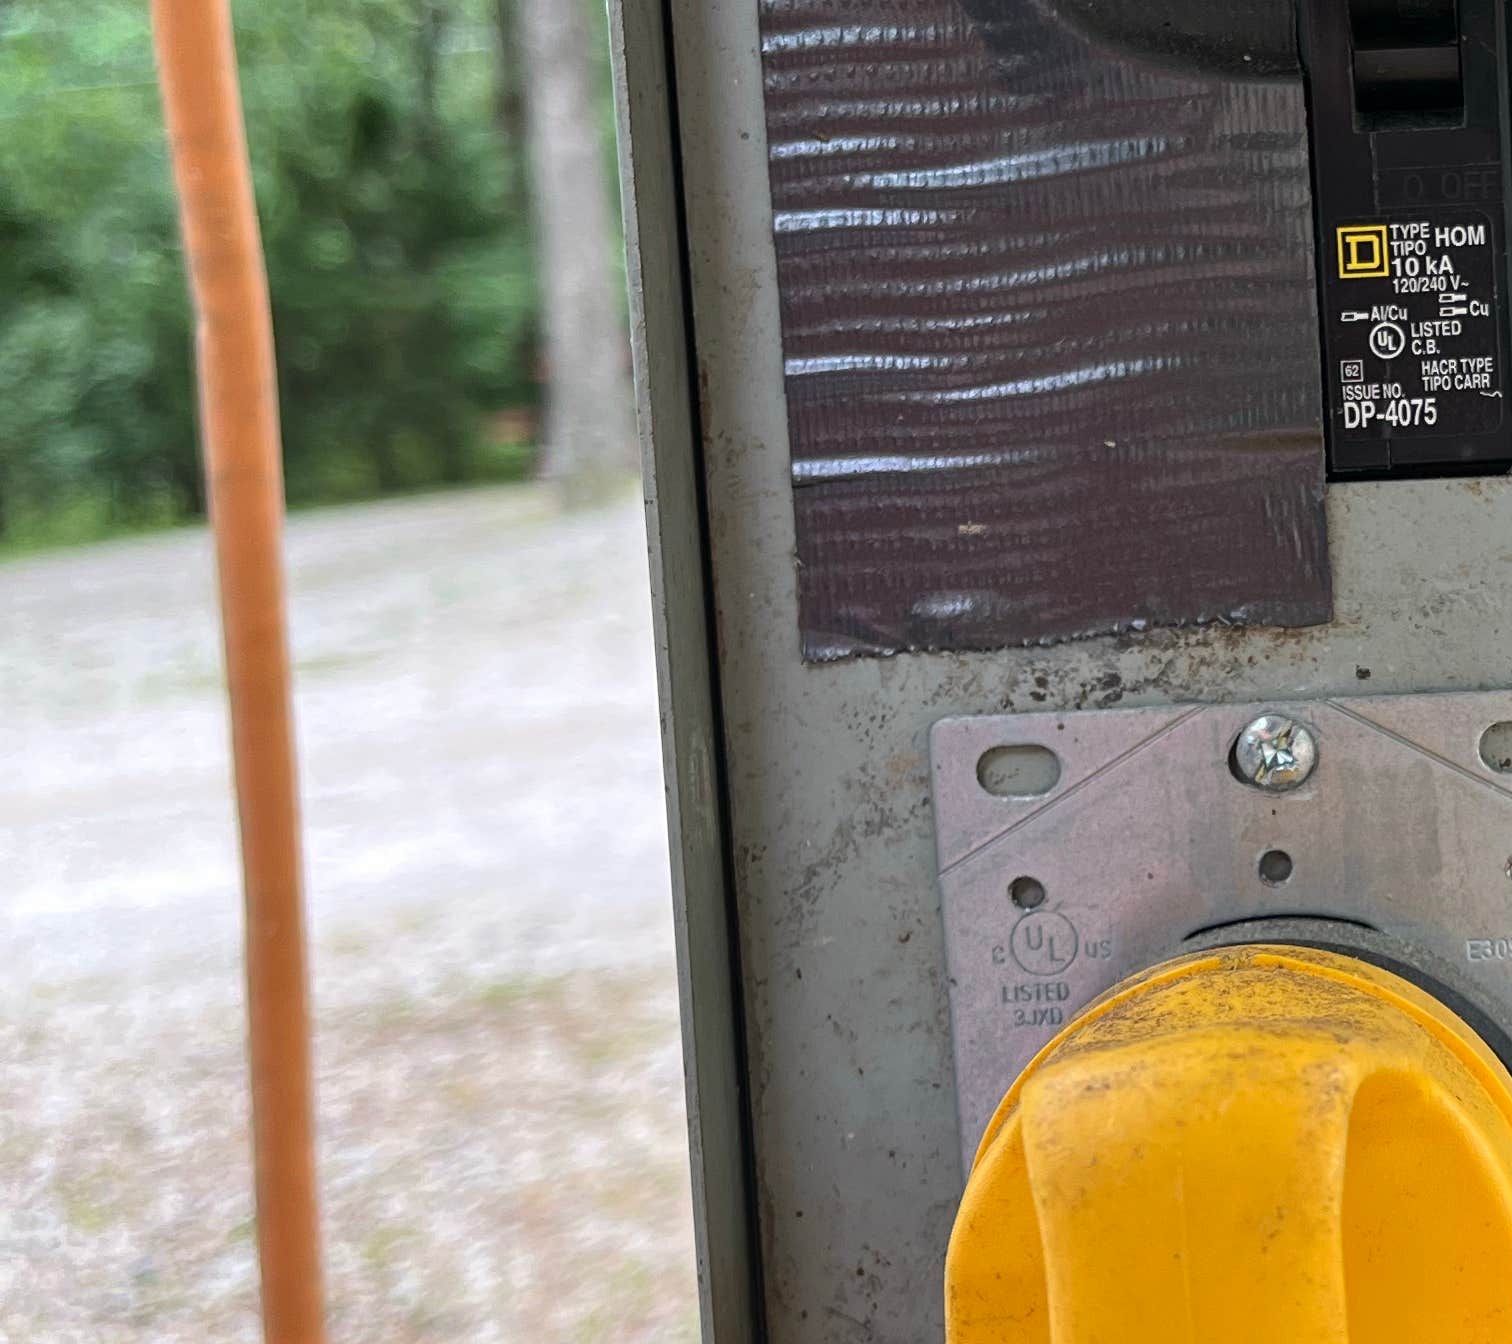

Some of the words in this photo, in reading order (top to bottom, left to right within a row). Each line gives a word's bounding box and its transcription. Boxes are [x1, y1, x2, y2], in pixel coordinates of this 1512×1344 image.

[1441, 169, 1497, 200] OFF
[1389, 223, 1430, 239] TYPE
[1434, 225, 1486, 248] HOM
[1390, 240, 1427, 256] TIPO
[1391, 257, 1420, 277] 10
[1425, 255, 1455, 275] kA
[1392, 276, 1447, 294] 120/240
[1469, 300, 1490, 317] Cu
[1410, 320, 1462, 338] LISTED
[1411, 340, 1441, 356] C.B.
[1345, 364, 1360, 378] 62
[1421, 359, 1458, 376] HACR
[1460, 357, 1494, 374] TYPE
[1422, 376, 1452, 392] TIPO
[1454, 373, 1491, 391] CARR
[1342, 384, 1380, 401] ISSUE
[1383, 383, 1406, 400] NO.
[1343, 398, 1438, 429] DP-4075
[1001, 981, 1071, 1004] LISTED
